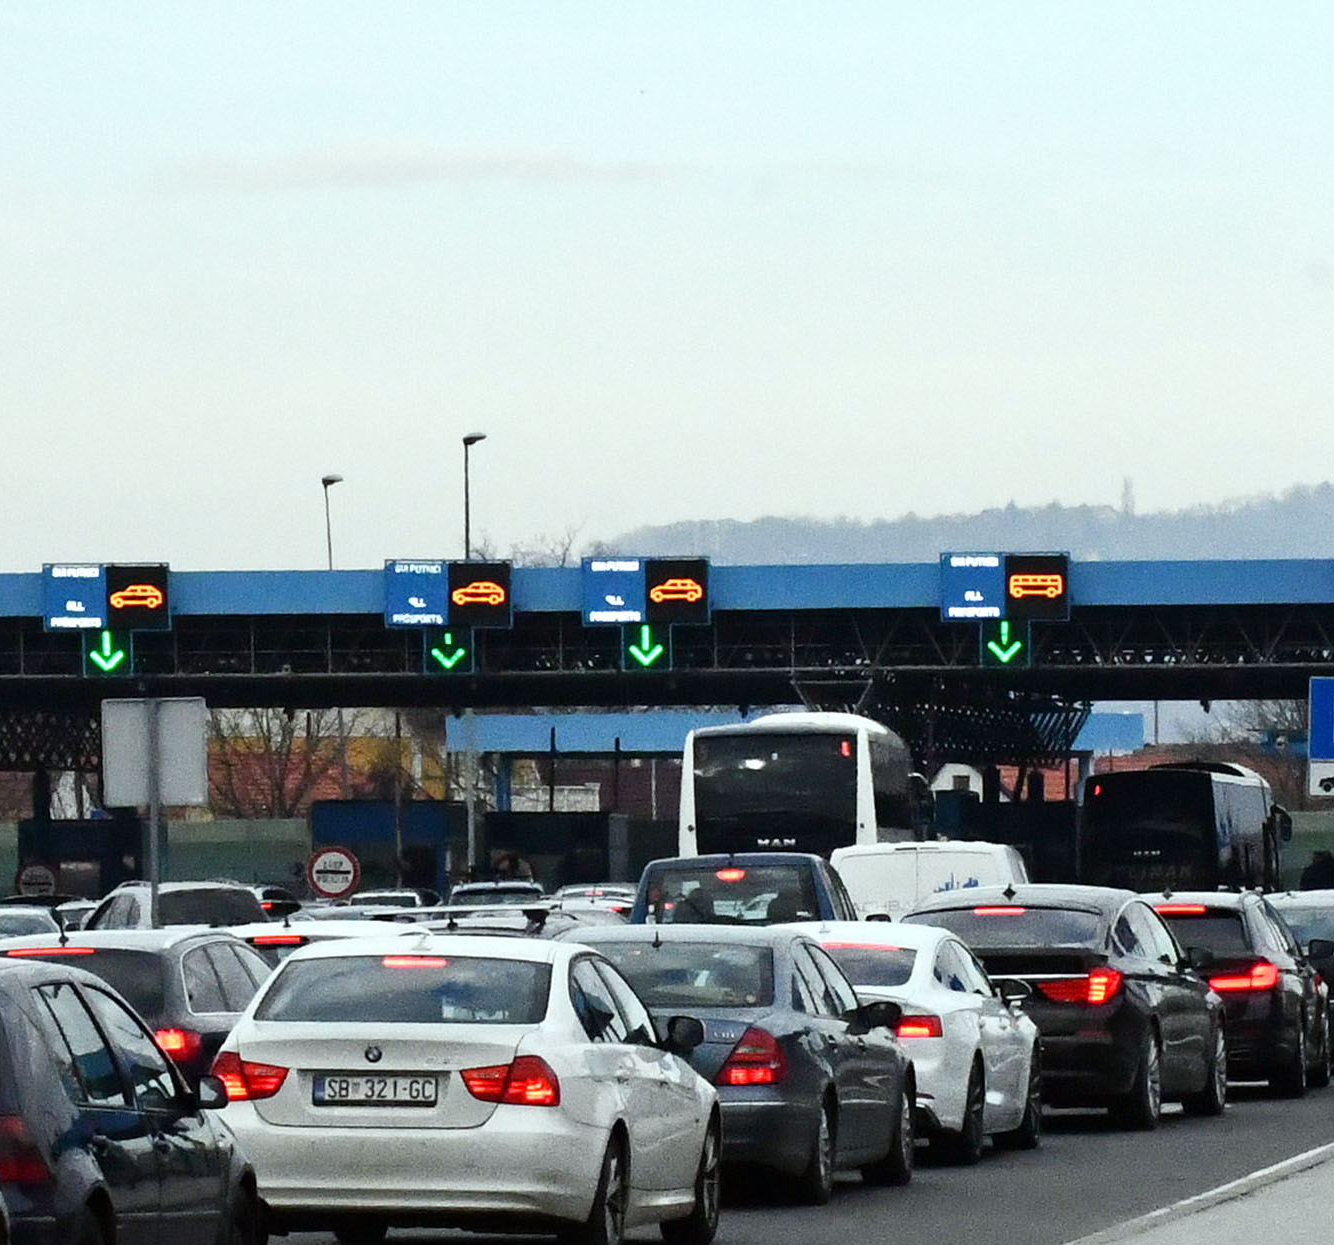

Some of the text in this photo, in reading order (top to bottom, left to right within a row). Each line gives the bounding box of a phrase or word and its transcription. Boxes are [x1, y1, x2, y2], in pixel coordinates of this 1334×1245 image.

[757, 838, 796, 848] MAN
[327, 1078, 434, 1100] SB 321-GC
